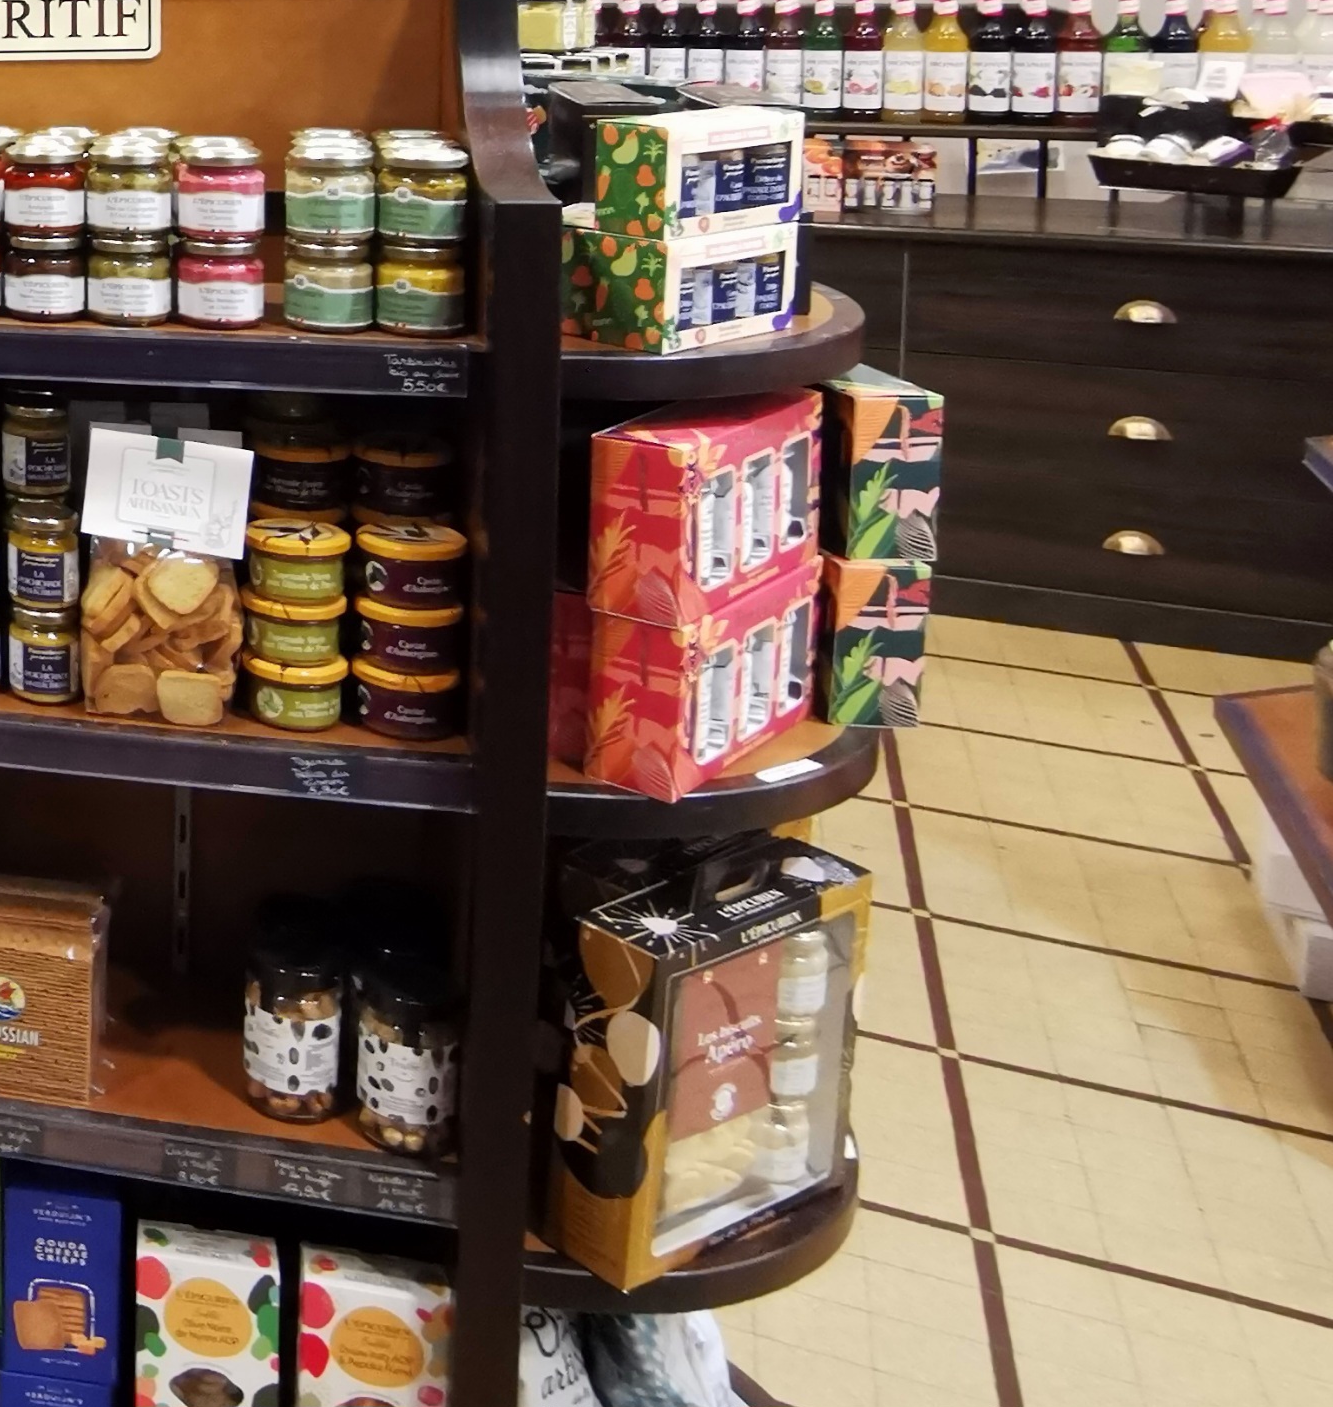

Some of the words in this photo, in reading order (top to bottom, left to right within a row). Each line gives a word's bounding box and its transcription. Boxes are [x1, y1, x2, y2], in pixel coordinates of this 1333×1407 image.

[131, 477, 204, 505] TOASTS
[35, 1236, 87, 1251] GOUDA
[34, 1244, 89, 1259] CHEESE
[36, 1252, 87, 1267] CRISPS
